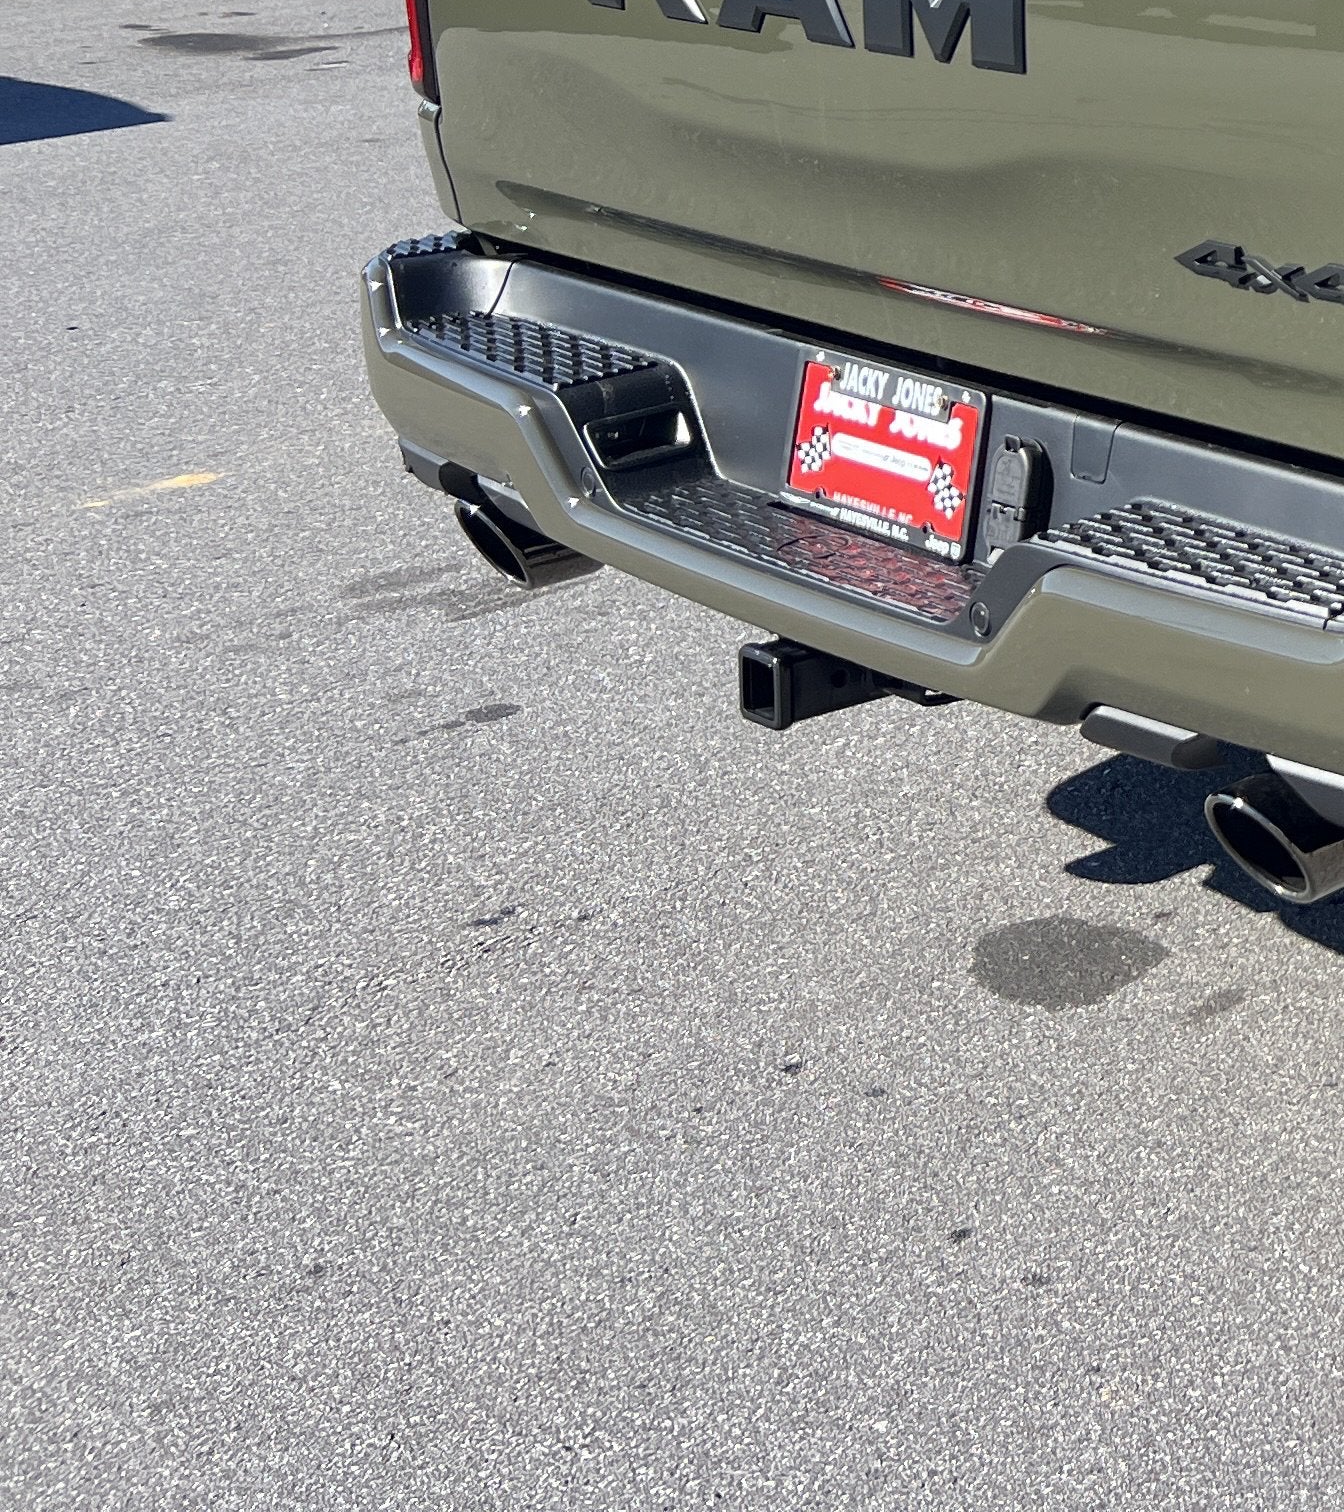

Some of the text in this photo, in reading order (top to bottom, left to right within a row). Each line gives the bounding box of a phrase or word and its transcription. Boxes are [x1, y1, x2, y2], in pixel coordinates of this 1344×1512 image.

[840, 362, 942, 416] JACKY JONES
[924, 534, 950, 557] Jeep
